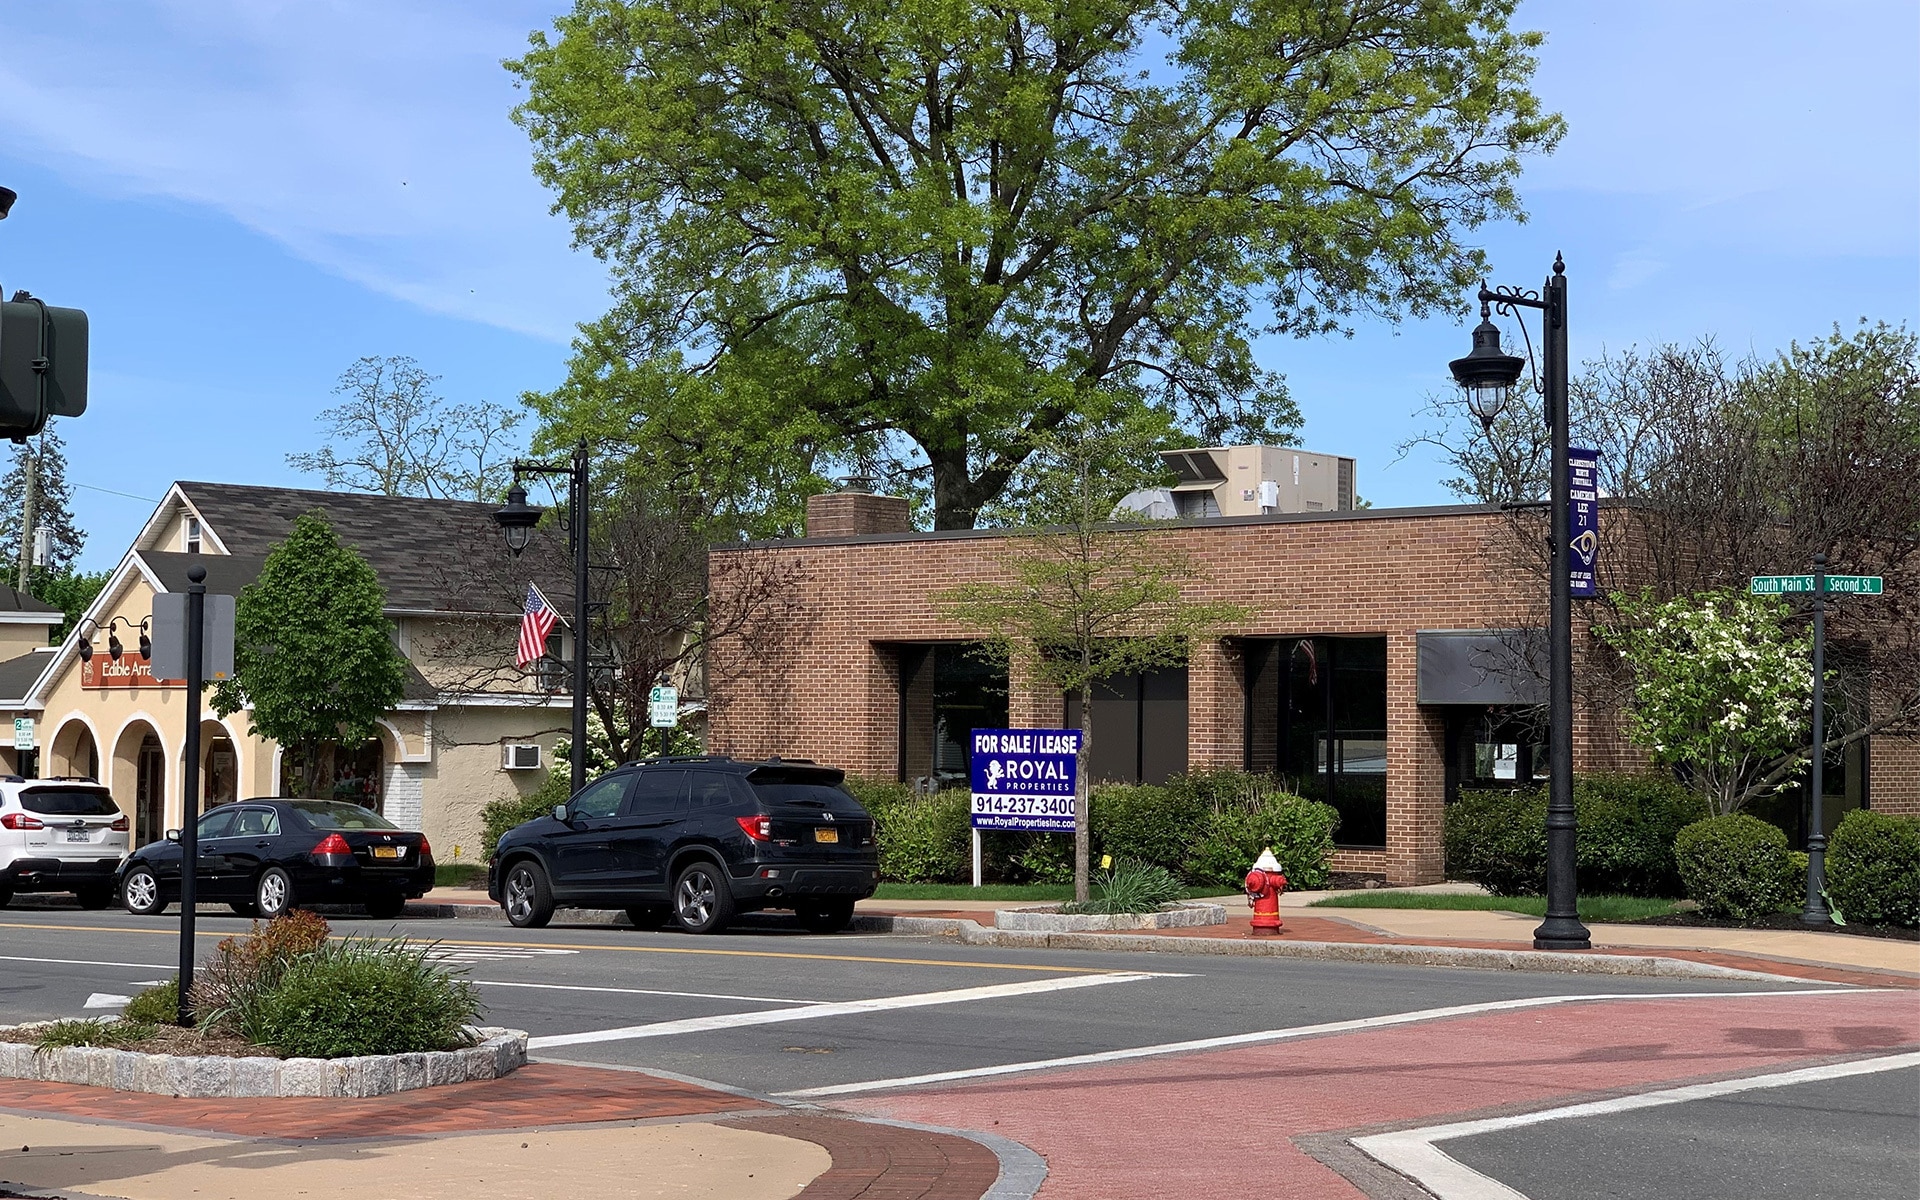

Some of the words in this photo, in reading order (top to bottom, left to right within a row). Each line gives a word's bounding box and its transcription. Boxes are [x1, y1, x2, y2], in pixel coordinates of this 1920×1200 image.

[1578, 514, 1587, 526] 21
[1753, 578, 1778, 592] South
[1781, 577, 1802, 592] Main
[1830, 578, 1859, 592] Second
[1862, 578, 1873, 592] St.
[102, 657, 131, 677] Edible
[653, 689, 660, 701] 2
[16, 720, 21, 730] 2
[975, 735, 998, 753] FOR
[1001, 735, 1031, 754] SALE
[1033, 735, 1037, 754] /
[1040, 735, 1077, 754] LEASE
[1006, 760, 1069, 779] ROYAL
[1006, 782, 1070, 791] PROPERTIES
[977, 796, 1075, 814] 914-237-3400
